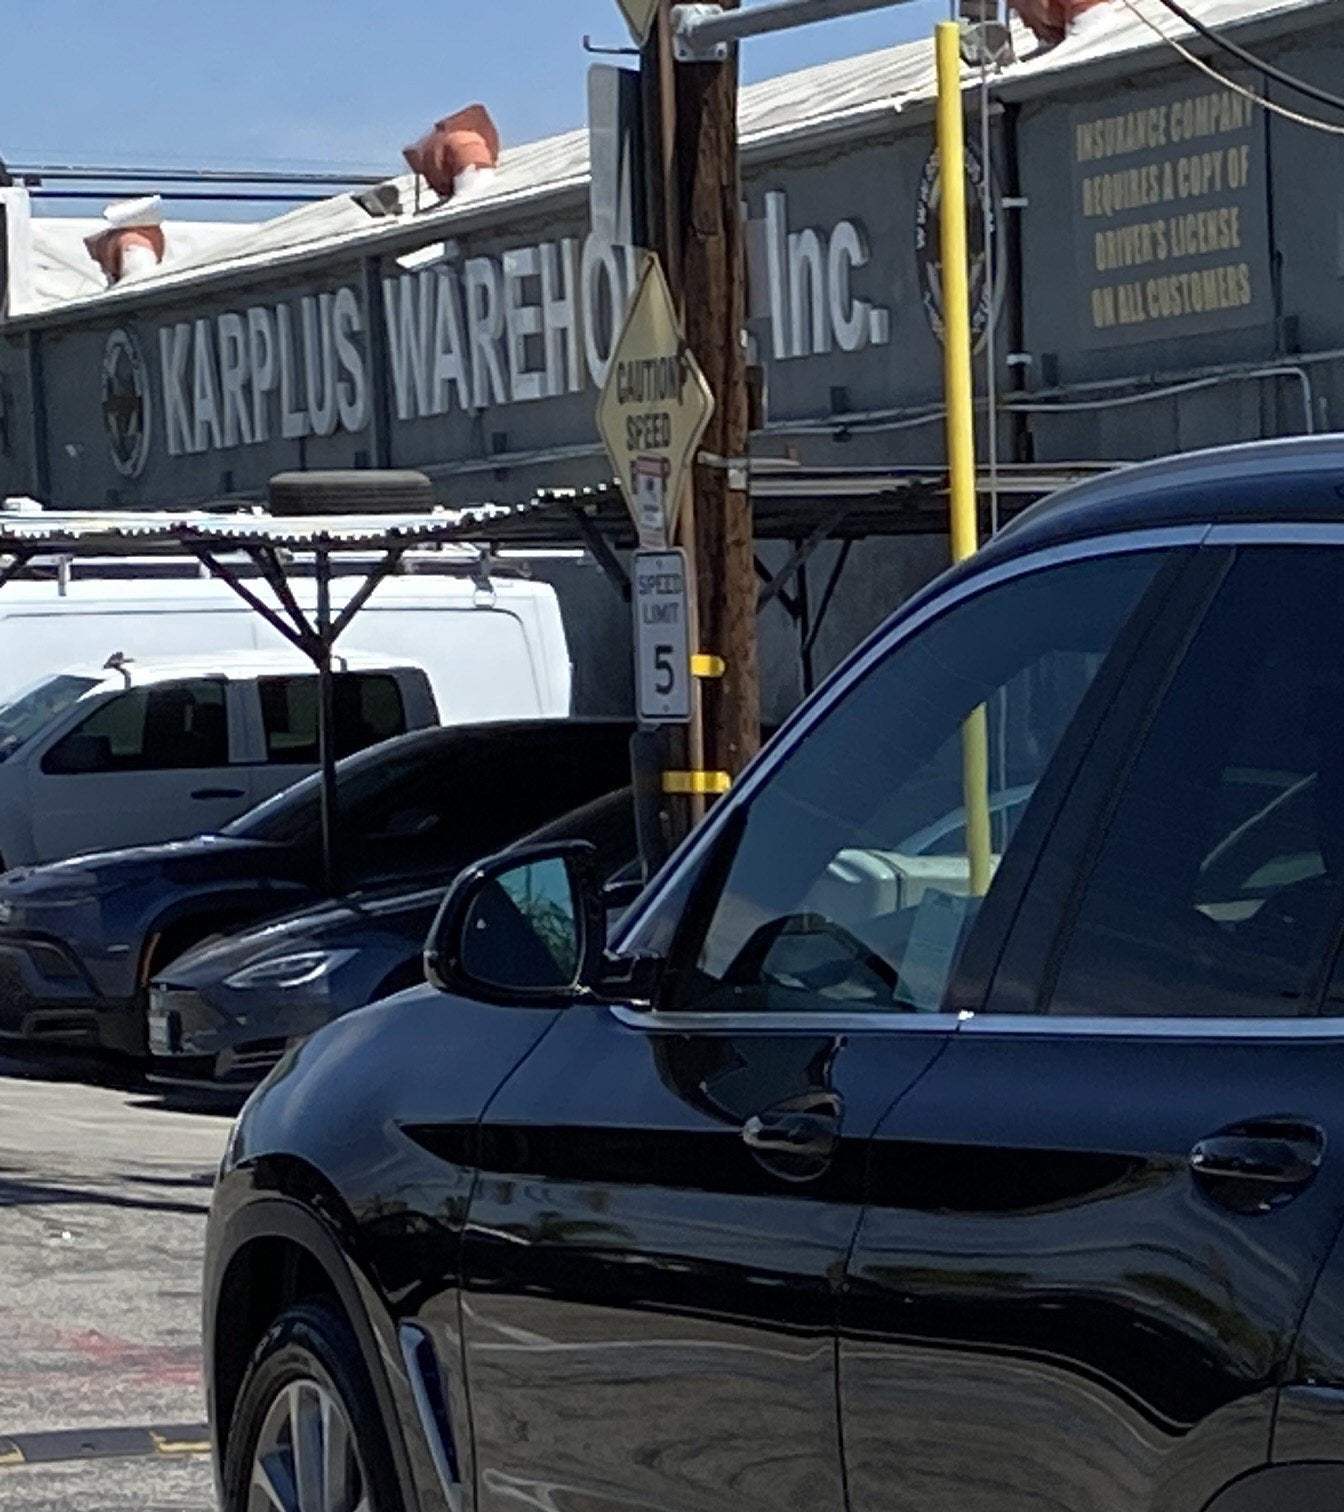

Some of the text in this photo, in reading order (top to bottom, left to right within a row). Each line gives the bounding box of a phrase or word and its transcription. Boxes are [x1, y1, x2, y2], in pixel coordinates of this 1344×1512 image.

[1077, 84, 1255, 162] INSURANCE COMPANY
[1083, 145, 1249, 217] REQUIRES A COPY OF
[1095, 206, 1240, 271] DRIVER'S LICENSE
[159, 288, 367, 457] KARPLUS
[383, 236, 638, 420] WAREHO
[765, 191, 889, 360] Inc.
[1092, 263, 1251, 328] ON ALL CUSTOMERS
[617, 356, 680, 404] CAUTION
[626, 412, 671, 451] SPEED
[638, 574, 683, 595] SPEED
[642, 602, 680, 625] LIMIT
[654, 645, 675, 695] 5
